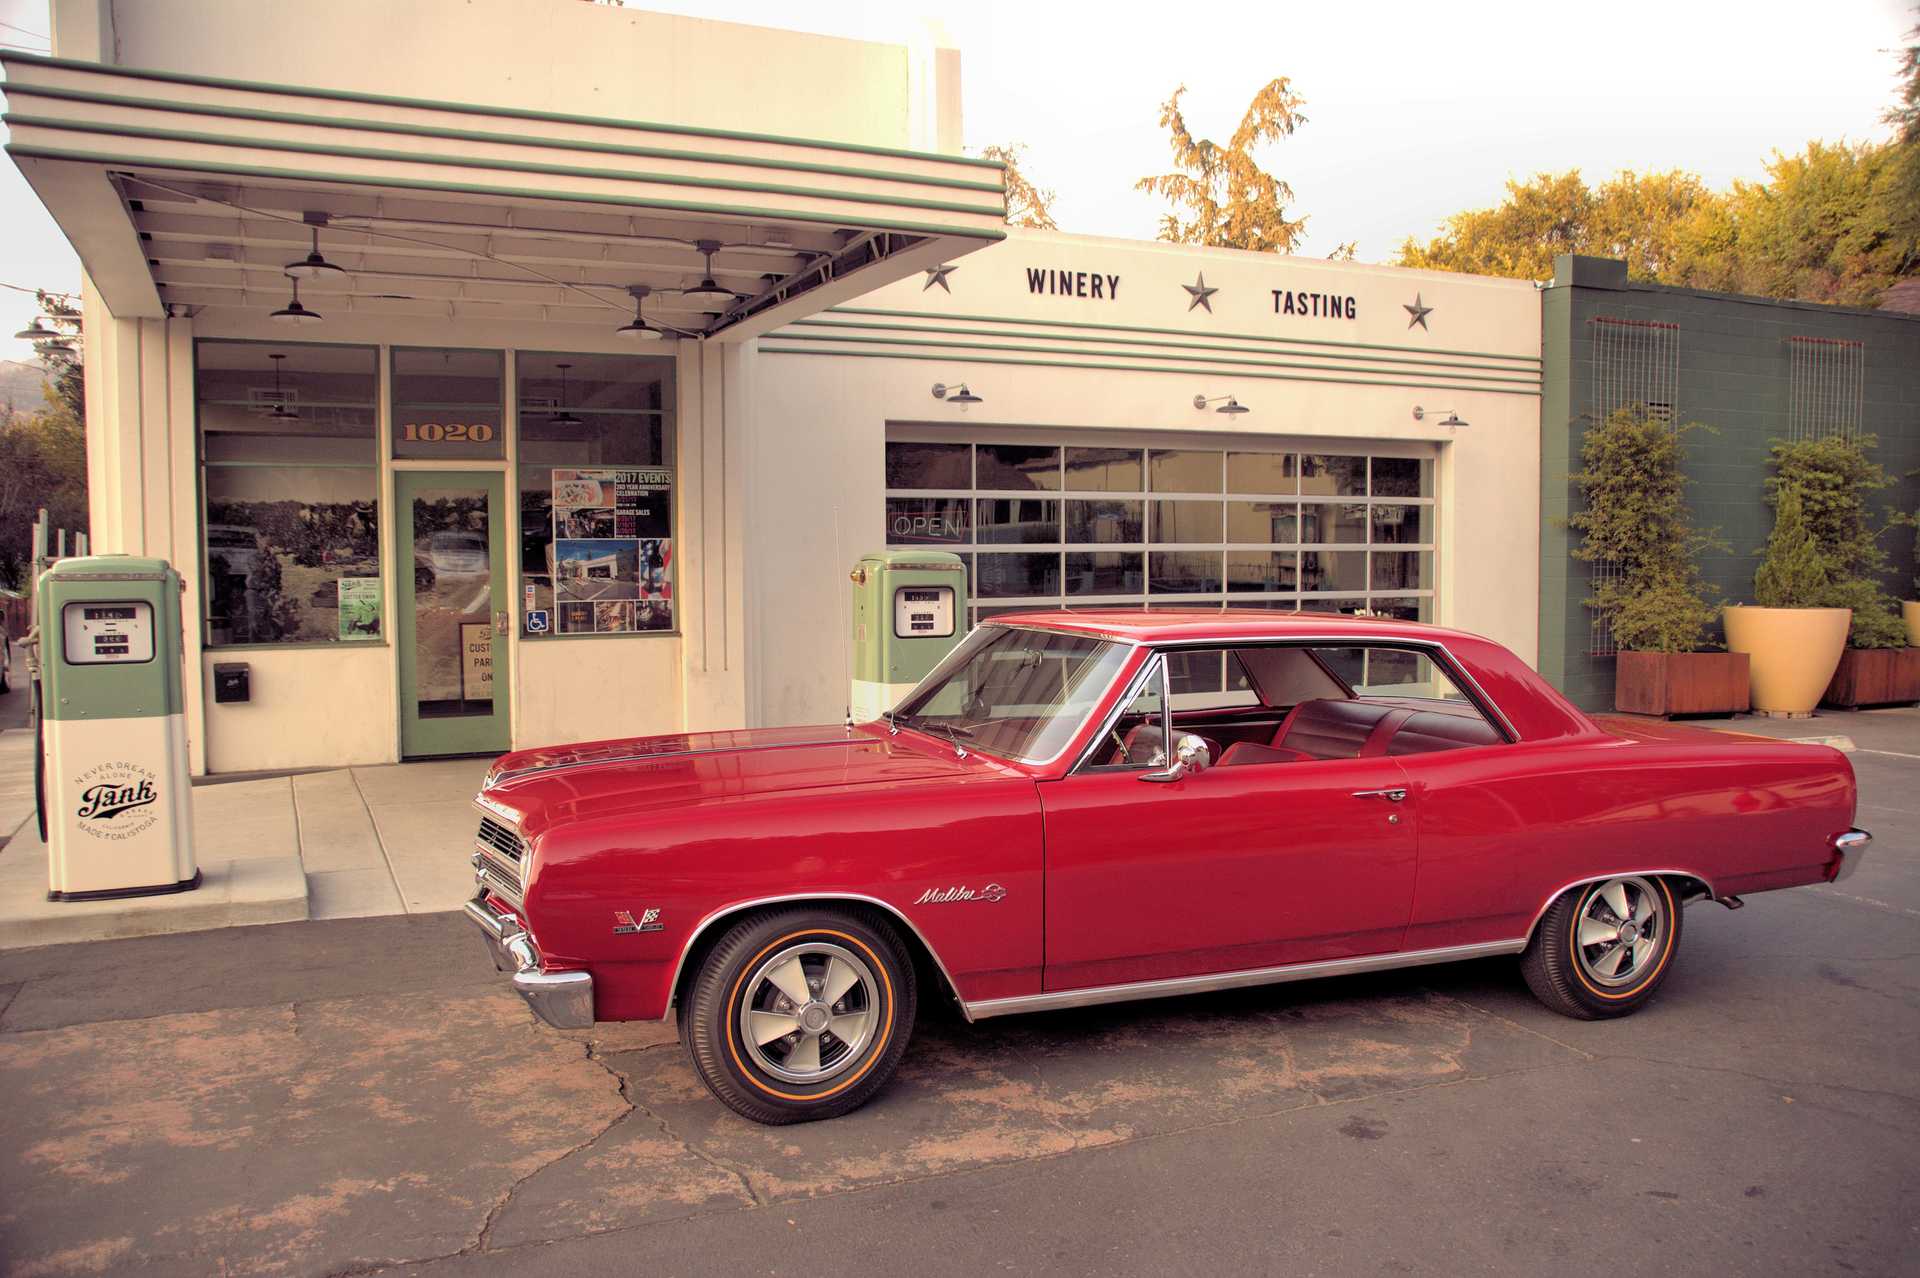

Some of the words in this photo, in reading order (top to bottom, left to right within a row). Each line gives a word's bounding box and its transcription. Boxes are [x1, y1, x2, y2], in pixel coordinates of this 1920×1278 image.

[1026, 267, 1120, 301] WINERY
[1271, 289, 1356, 320] TASTING
[402, 423, 493, 443] 1020
[616, 472, 638, 484] 2017
[638, 472, 672, 484] EVENTS
[894, 516, 960, 537] OPEN
[473, 658, 493, 668] PAR
[74, 762, 113, 784] NEVER
[116, 761, 156, 780] DREAM
[100, 772, 132, 780] ALONE
[78, 779, 157, 820] Tank
[78, 821, 104, 839] MADE
[111, 816, 158, 840] CALISTOGA
[914, 886, 981, 905] Malibu
